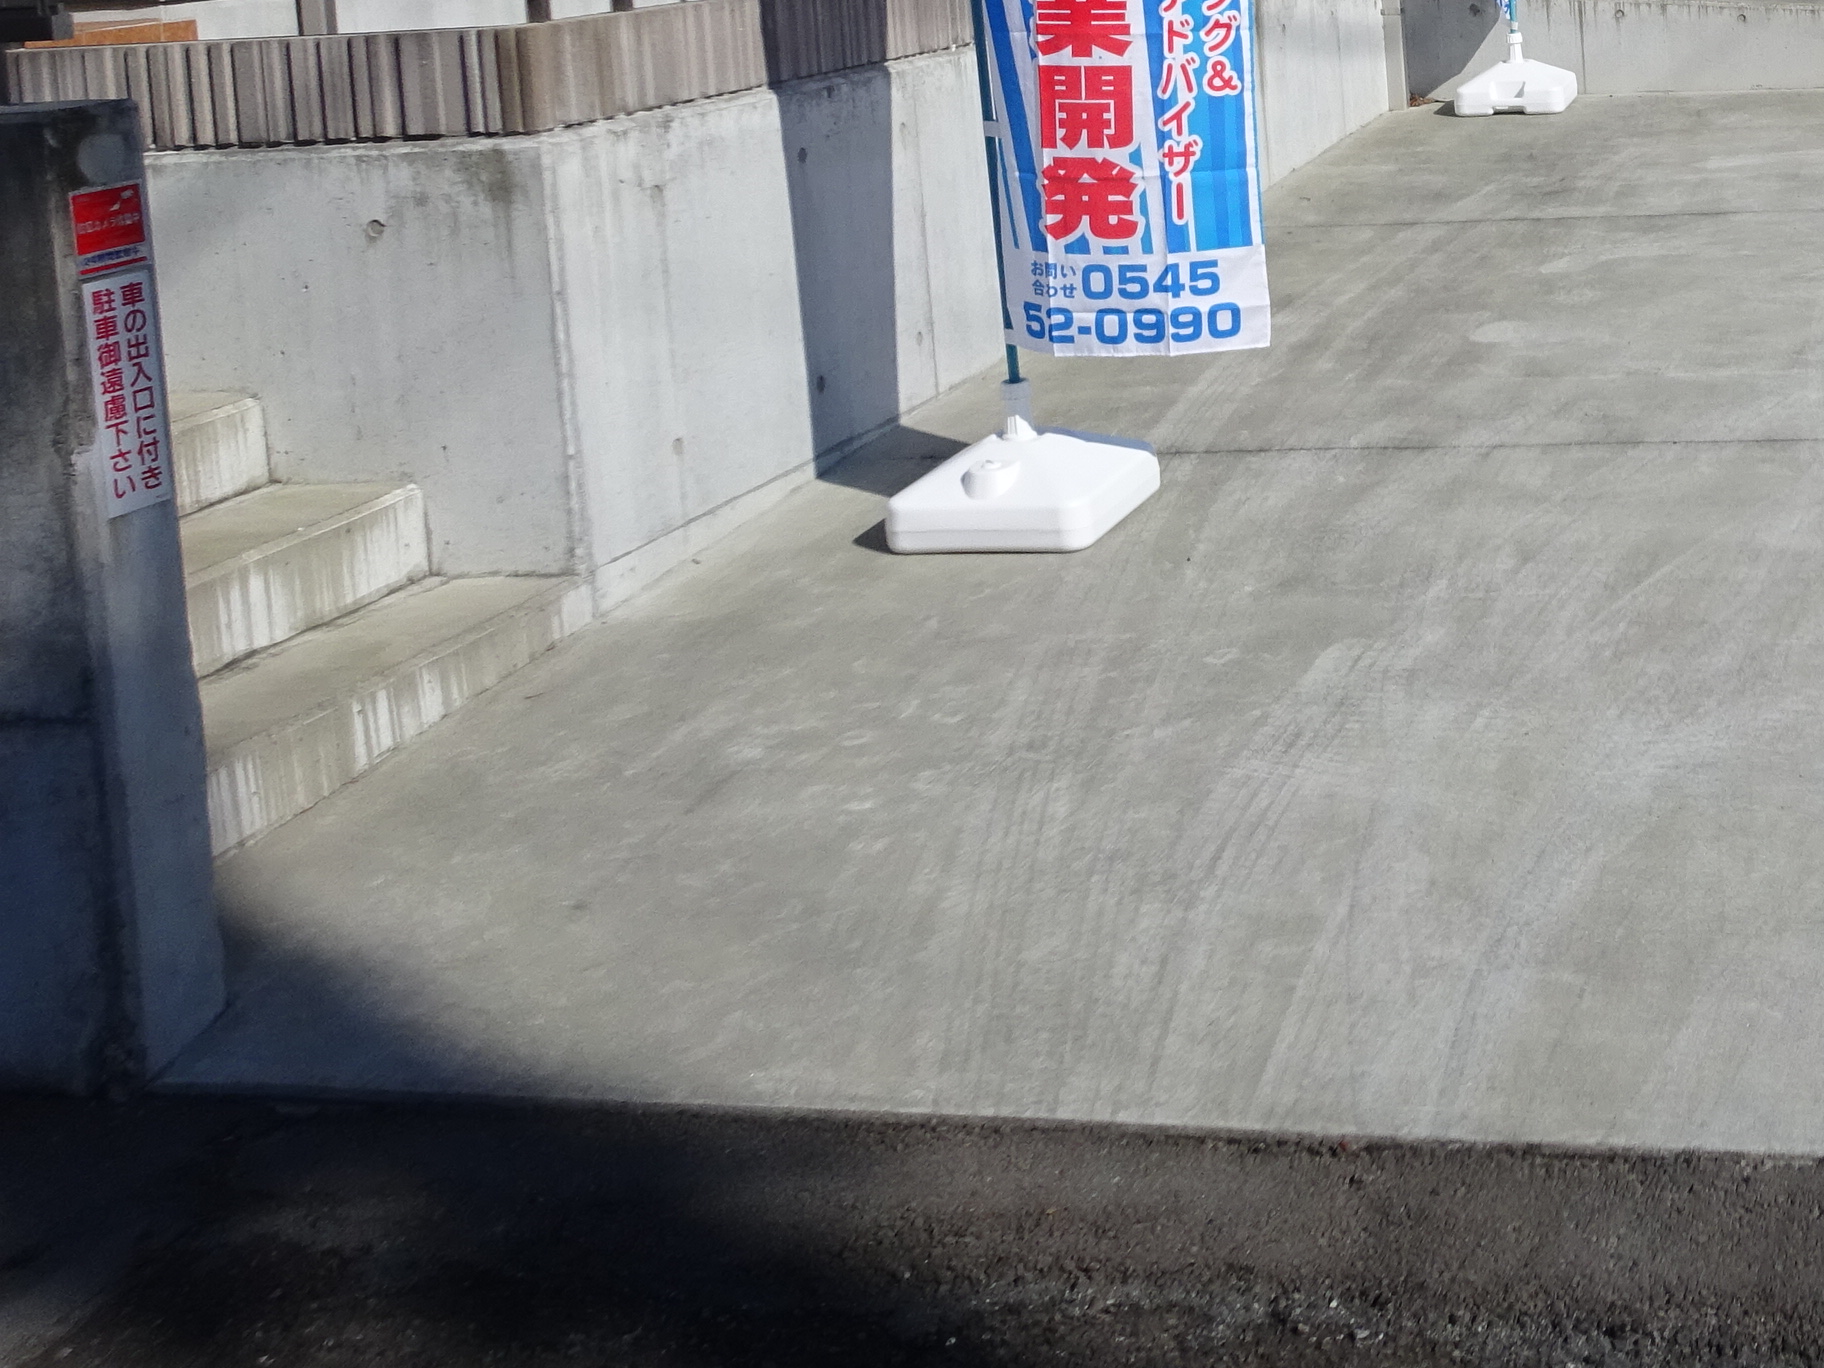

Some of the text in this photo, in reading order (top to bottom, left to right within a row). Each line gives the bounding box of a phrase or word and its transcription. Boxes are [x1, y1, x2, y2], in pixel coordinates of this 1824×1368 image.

[1030, 259, 1077, 280] お問い
[1031, 279, 1077, 299] 合わせ
[1081, 259, 1221, 300] 0545
[1022, 301, 1242, 345] 52-0990
[91, 288, 137, 499] 駐車御遠慮下さい
[119, 281, 163, 490] 車の出入口に付き
